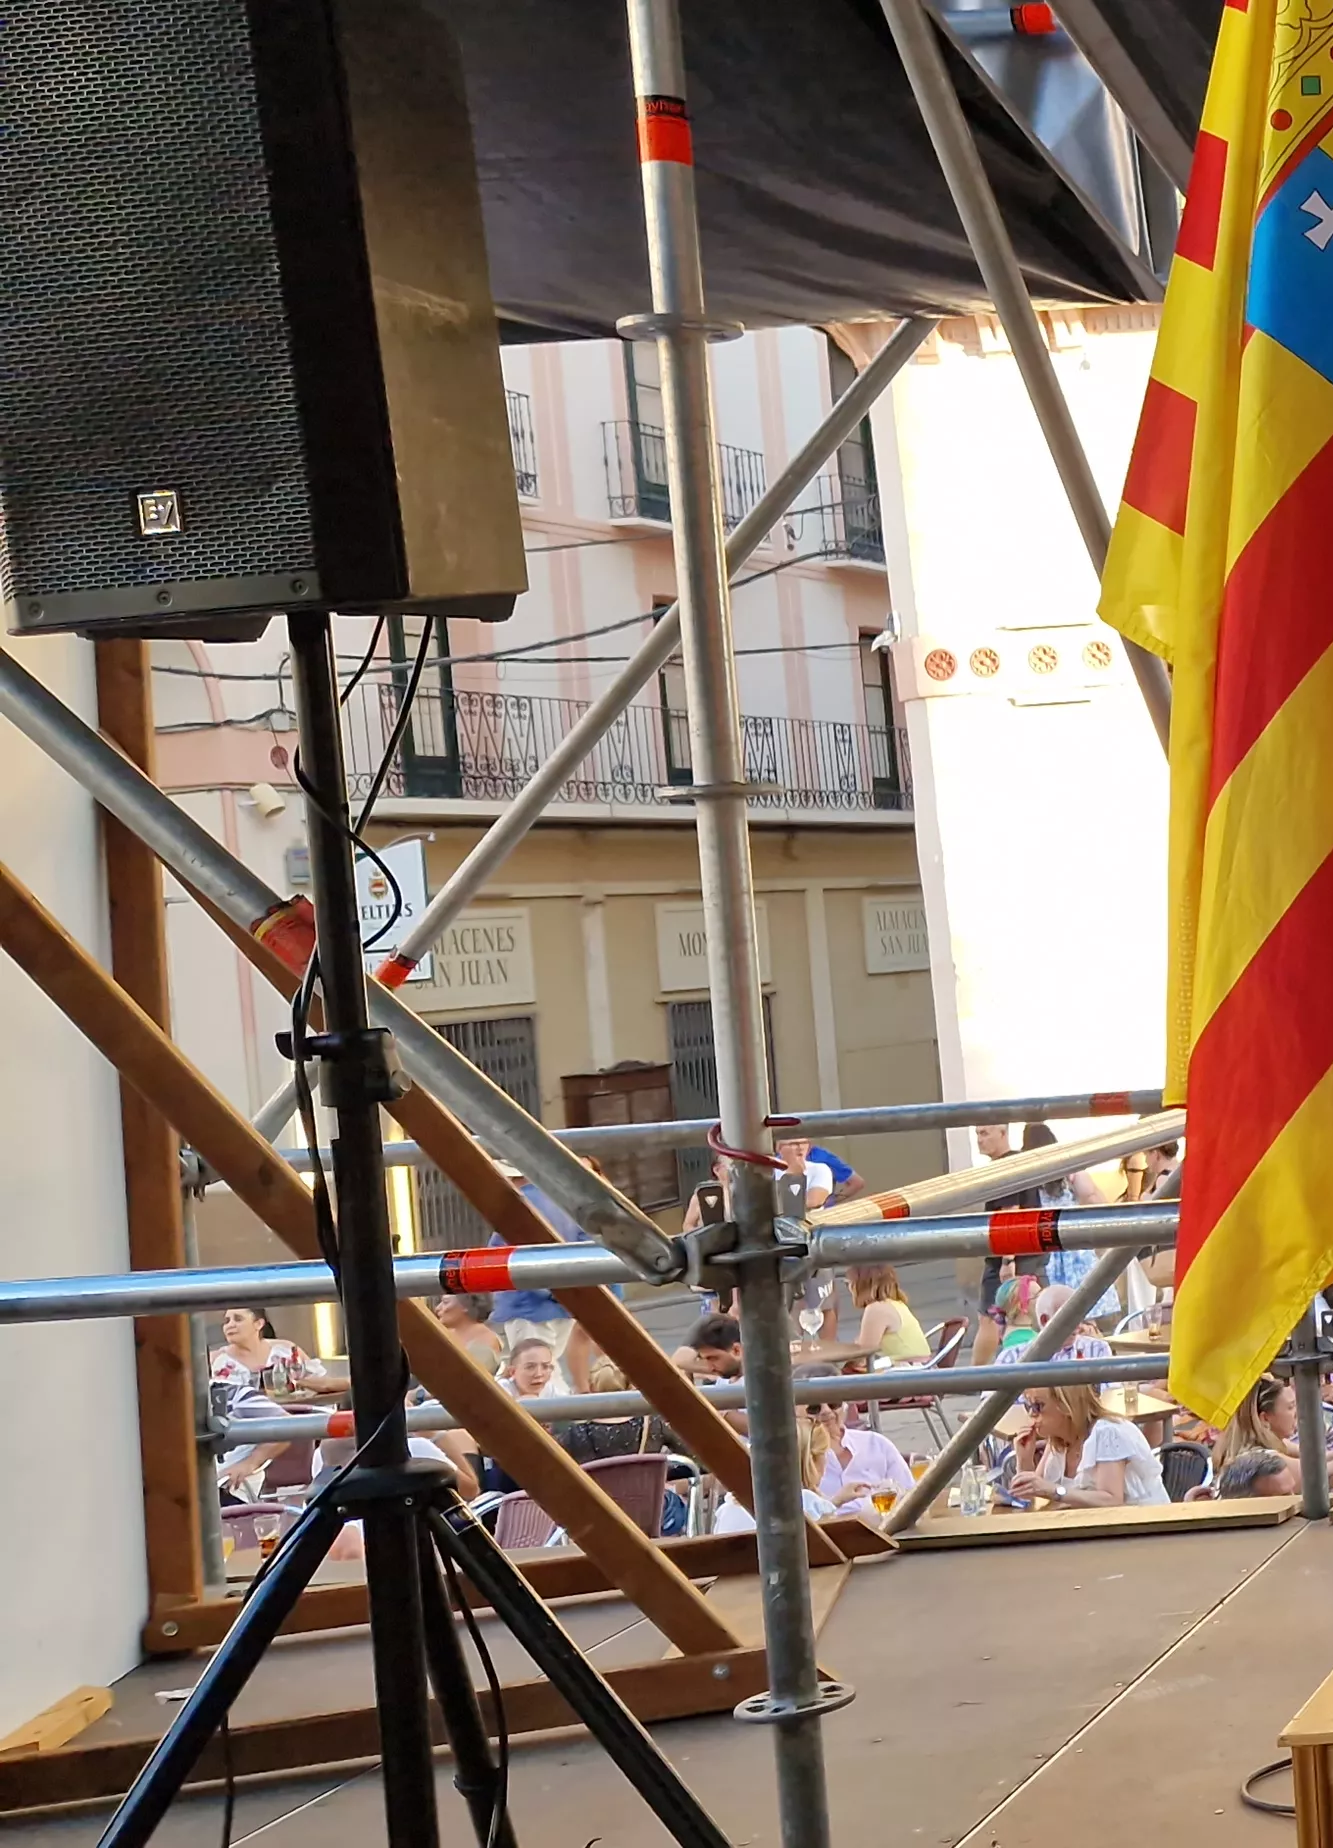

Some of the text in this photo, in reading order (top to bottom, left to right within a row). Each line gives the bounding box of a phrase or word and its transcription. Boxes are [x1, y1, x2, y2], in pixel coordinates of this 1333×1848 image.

[361, 902, 413, 920] ELTIS
[433, 927, 515, 956] MACENES
[908, 933, 929, 954] JUA
[458, 959, 509, 987] JUAN
